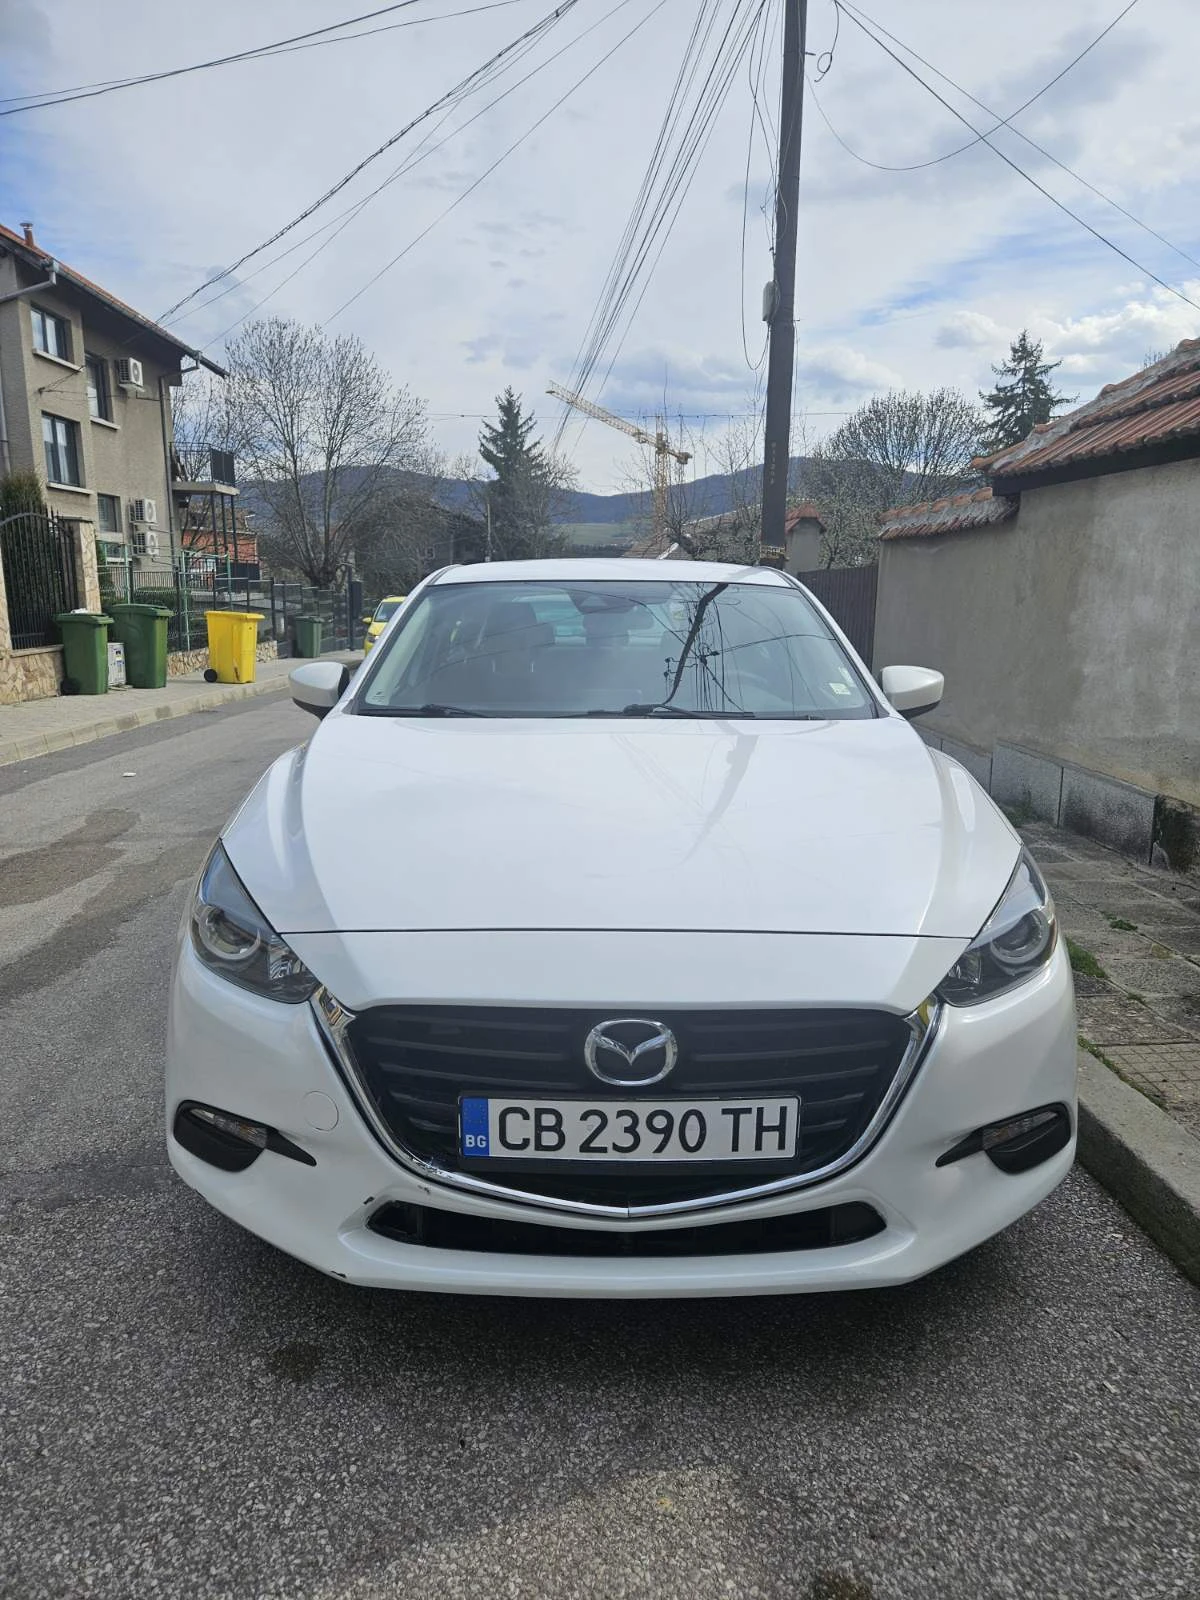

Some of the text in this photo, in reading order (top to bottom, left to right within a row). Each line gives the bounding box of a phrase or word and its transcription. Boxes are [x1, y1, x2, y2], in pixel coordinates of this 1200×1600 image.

[465, 1134, 487, 1149] BG
[498, 1105, 788, 1154] CB 2390 TH
